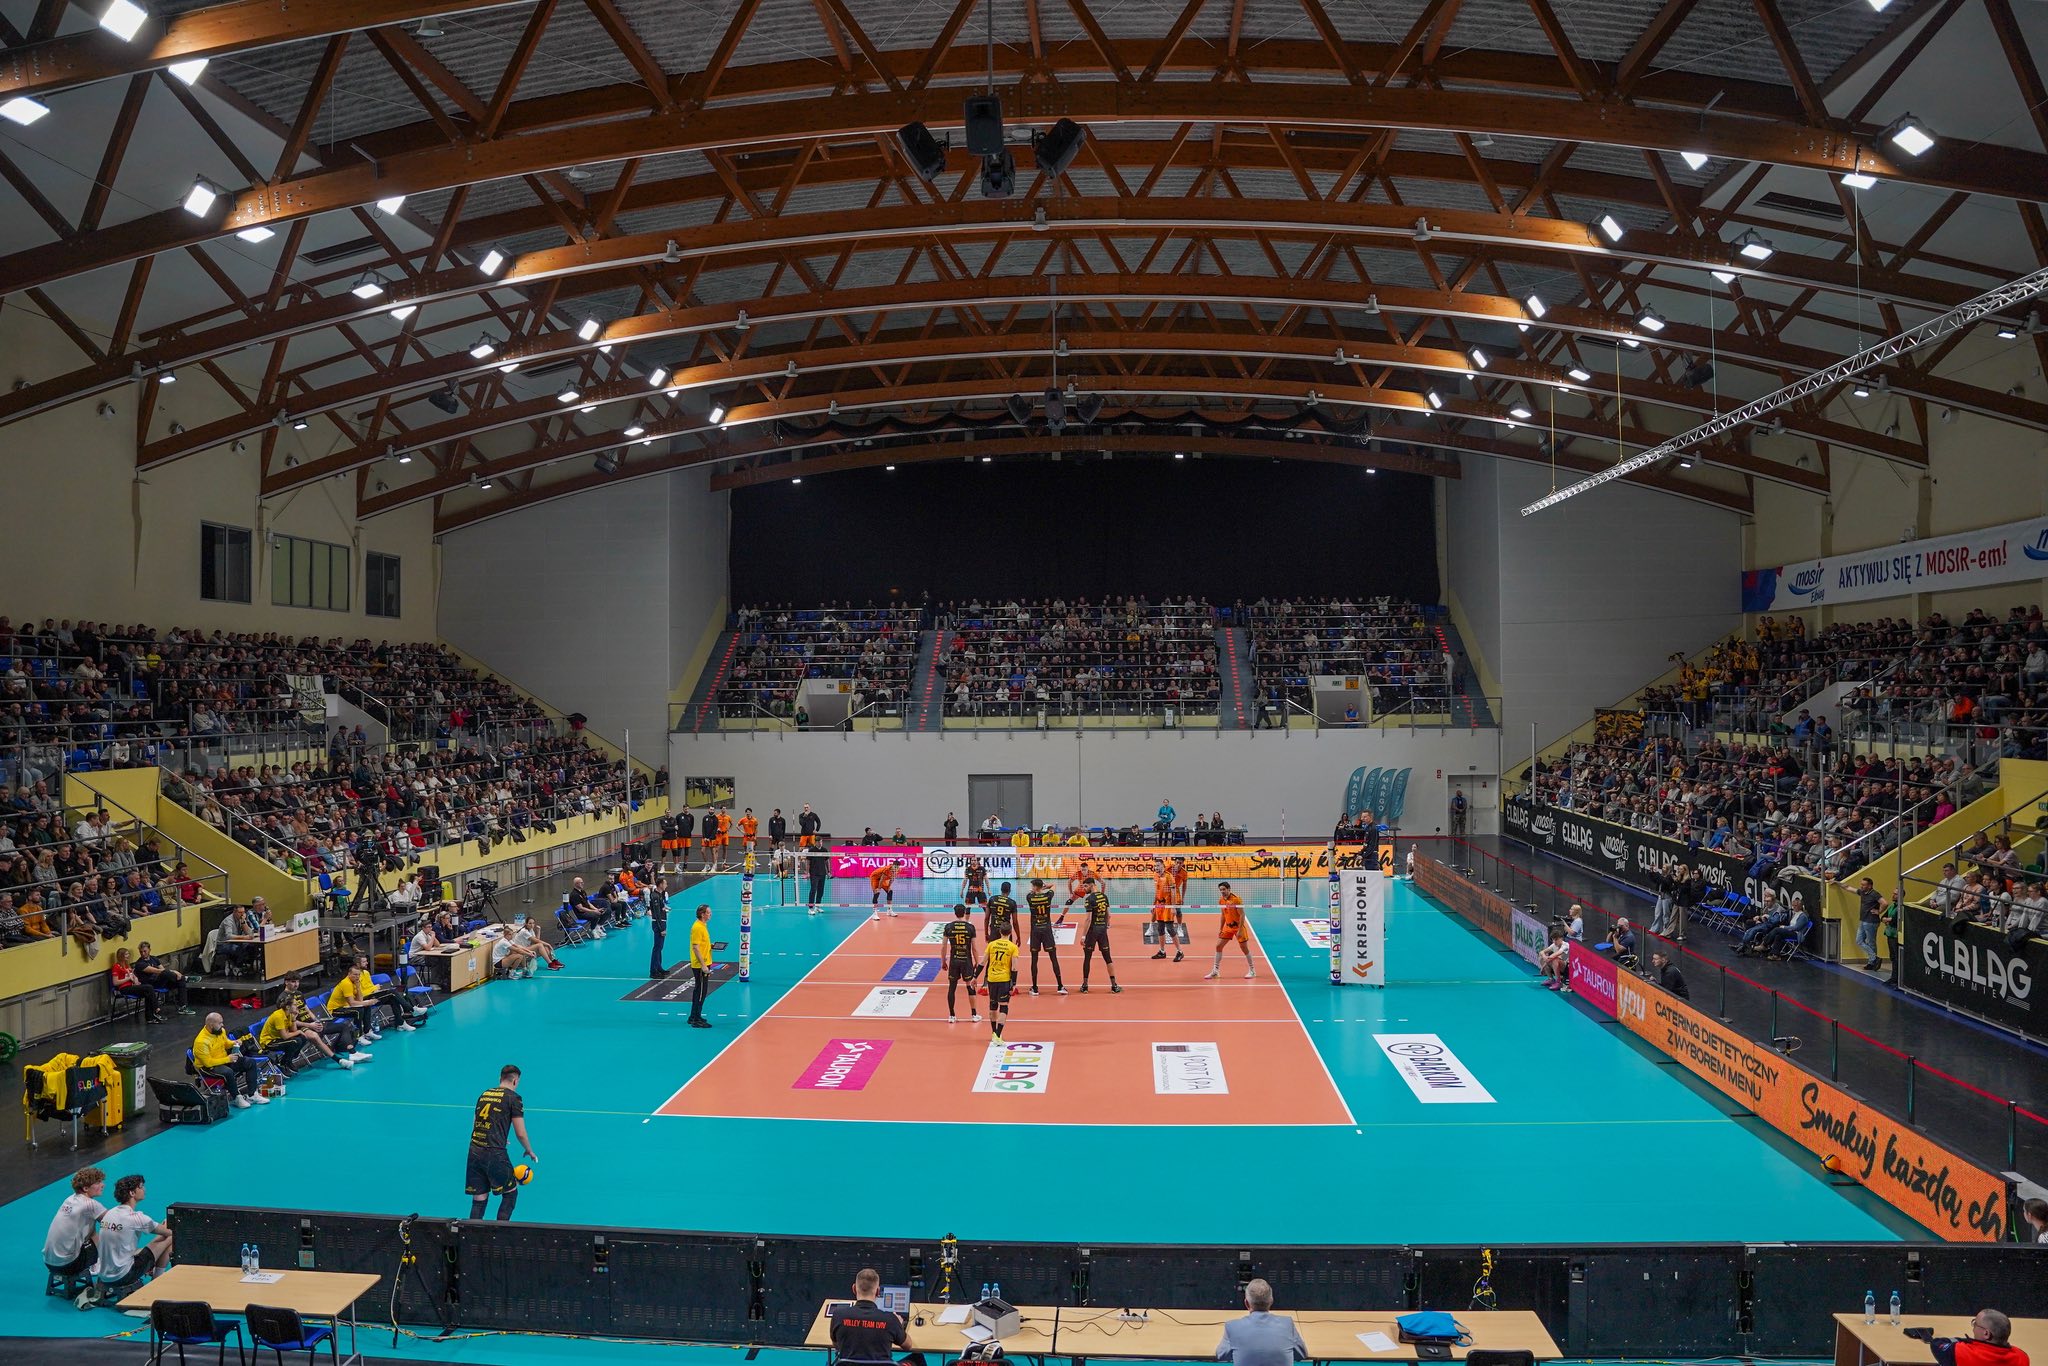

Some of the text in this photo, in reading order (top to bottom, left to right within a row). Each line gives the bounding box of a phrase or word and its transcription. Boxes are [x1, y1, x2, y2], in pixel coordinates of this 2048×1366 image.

[1795, 562, 1825, 586] mosir
[1838, 540, 2007, 589] AKTYWUJ SIĘ Z MOSIR-em!
[1350, 776, 1360, 810] MARGO
[1378, 776, 1389, 811] MARGO
[1535, 812, 1553, 829] mosir
[1605, 833, 1625, 853] mosir
[860, 857, 919, 869] TAURON
[1096, 864, 1104, 872] Z
[1698, 861, 1727, 886] mosir
[997, 906, 1004, 916] 9
[1036, 905, 1046, 915] 11
[1356, 876, 1367, 959] KRISHOME
[954, 934, 966, 945] 15
[1514, 920, 1534, 949] plus
[994, 950, 1006, 962] 17
[1582, 965, 1615, 1001] TAURON
[1924, 966, 1998, 999] W FORMIE
[1618, 983, 1647, 1022] you
[1655, 1001, 1779, 1087] CATERING DIETETYCZNY
[814, 1052, 862, 1087] TAURON
[1409, 1057, 1466, 1088] BARKOM
[1667, 1028, 1762, 1101] Z WYBOREM MENU
[479, 1103, 491, 1120] 4
[1800, 1082, 1878, 1180] Smakuj
[1883, 1134, 1963, 1228] każdą
[843, 1319, 887, 1329] VOLLEY TEAM LVIV
